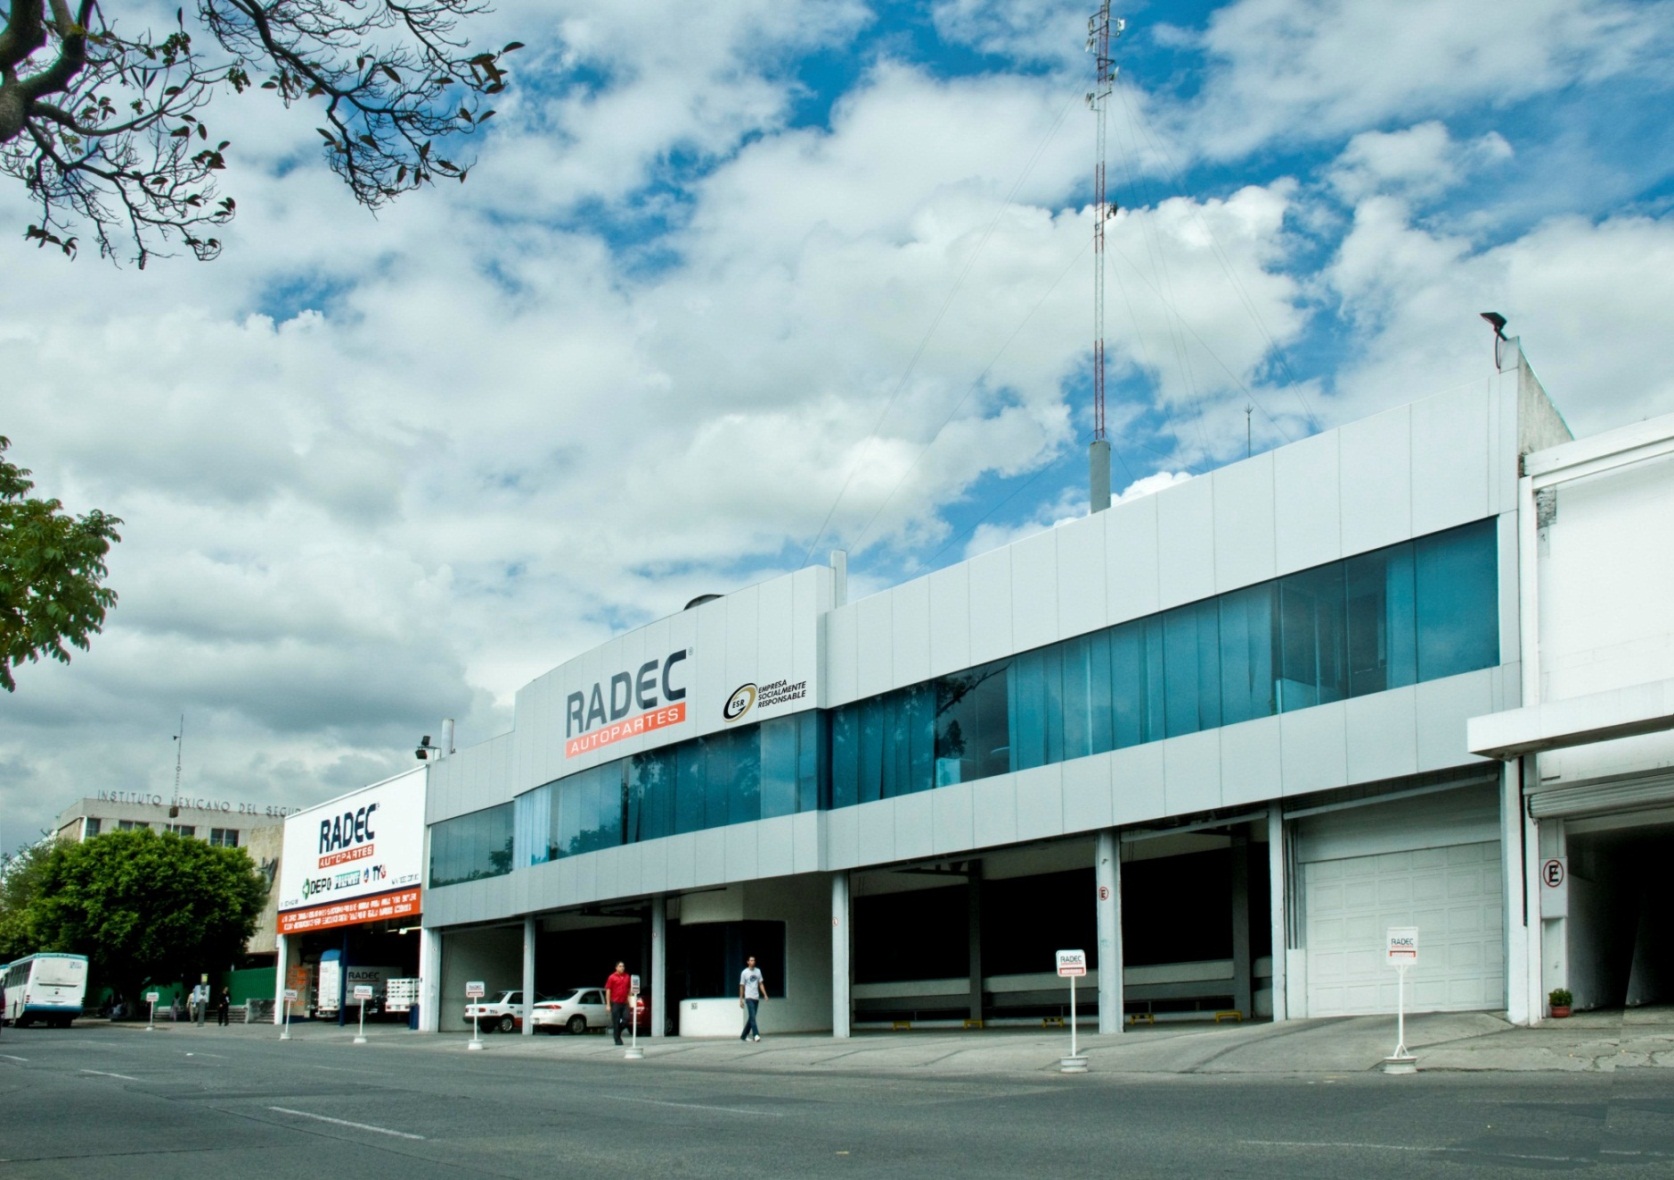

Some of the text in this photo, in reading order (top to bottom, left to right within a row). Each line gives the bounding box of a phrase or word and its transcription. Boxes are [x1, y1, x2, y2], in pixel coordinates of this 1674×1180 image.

[566, 649, 687, 738] RADEC
[758, 679, 787, 693] EMPRESA
[758, 681, 807, 700] SOCIALMENTE
[732, 699, 745, 708] ESR
[758, 690, 807, 708] RESPONSABLE
[570, 707, 680, 755] AUTOPARTES
[97, 789, 162, 806] INSTITUTO
[171, 796, 231, 812] MEXICANO
[239, 803, 257, 815] DEL
[319, 803, 377, 854] RADEC
[319, 845, 374, 867] AUTOPARTES
[1549, 864, 1559, 883] E
[310, 877, 332, 895] DEPO
[1391, 937, 1414, 946] RADEC
[1060, 955, 1082, 963] RADEC
[348, 971, 380, 979] RADEC
